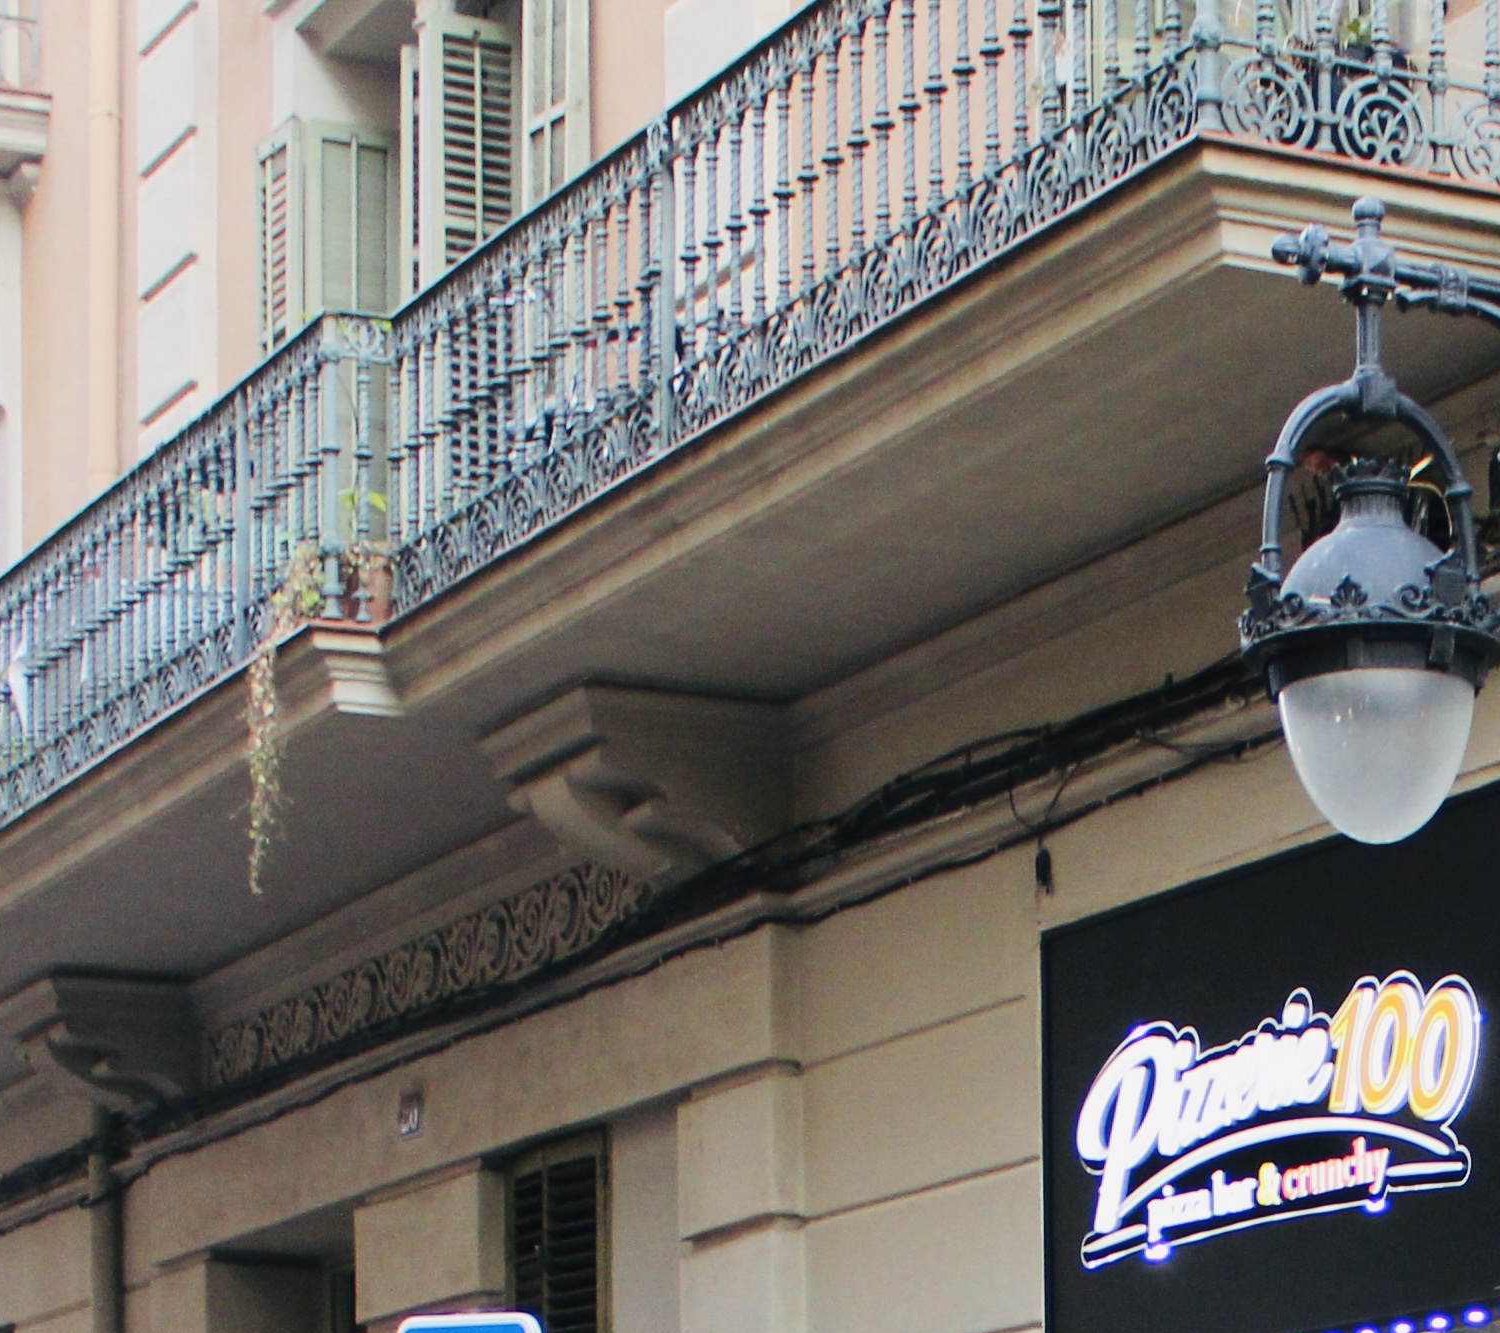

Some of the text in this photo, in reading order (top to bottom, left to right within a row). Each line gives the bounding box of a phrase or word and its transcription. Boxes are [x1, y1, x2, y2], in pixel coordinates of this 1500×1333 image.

[1328, 984, 1476, 1121] 100
[1256, 1162, 1282, 1206] &
[1281, 1136, 1390, 1195] crunchy
